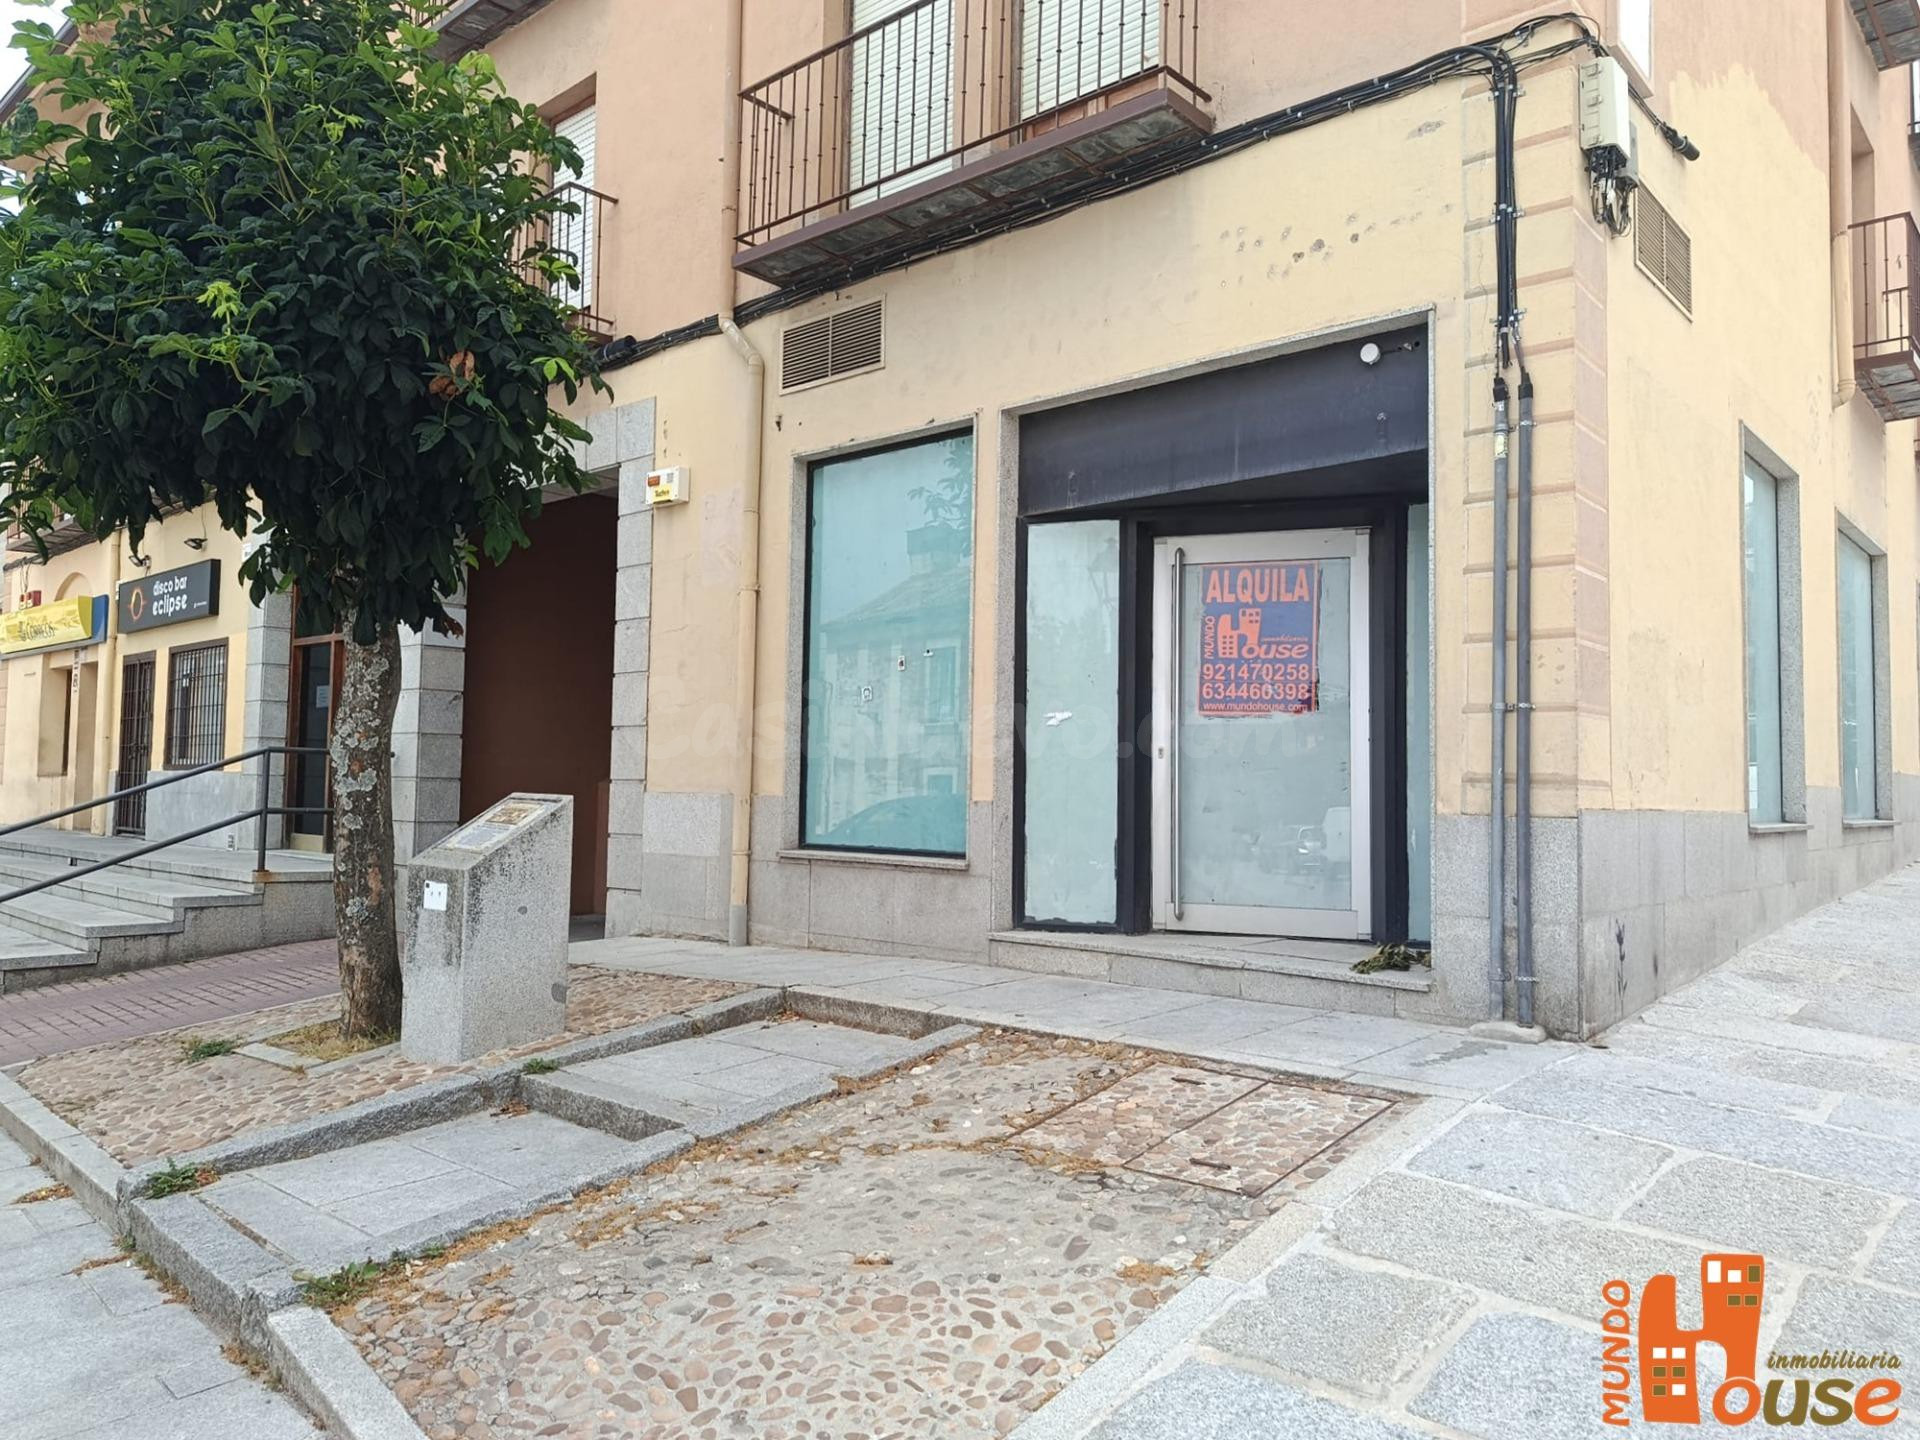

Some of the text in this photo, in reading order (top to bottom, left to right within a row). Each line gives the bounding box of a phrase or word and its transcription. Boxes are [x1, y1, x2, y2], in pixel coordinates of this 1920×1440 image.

[153, 575, 187, 596] disco bar
[1206, 568, 1309, 603] ALQUILA
[152, 594, 187, 617] eclipse
[1204, 616, 1215, 659] MUNDO
[1203, 663, 1309, 681] 921470258
[1202, 683, 1309, 700] 634460398
[1203, 702, 1308, 713] www.mundohouse.com
